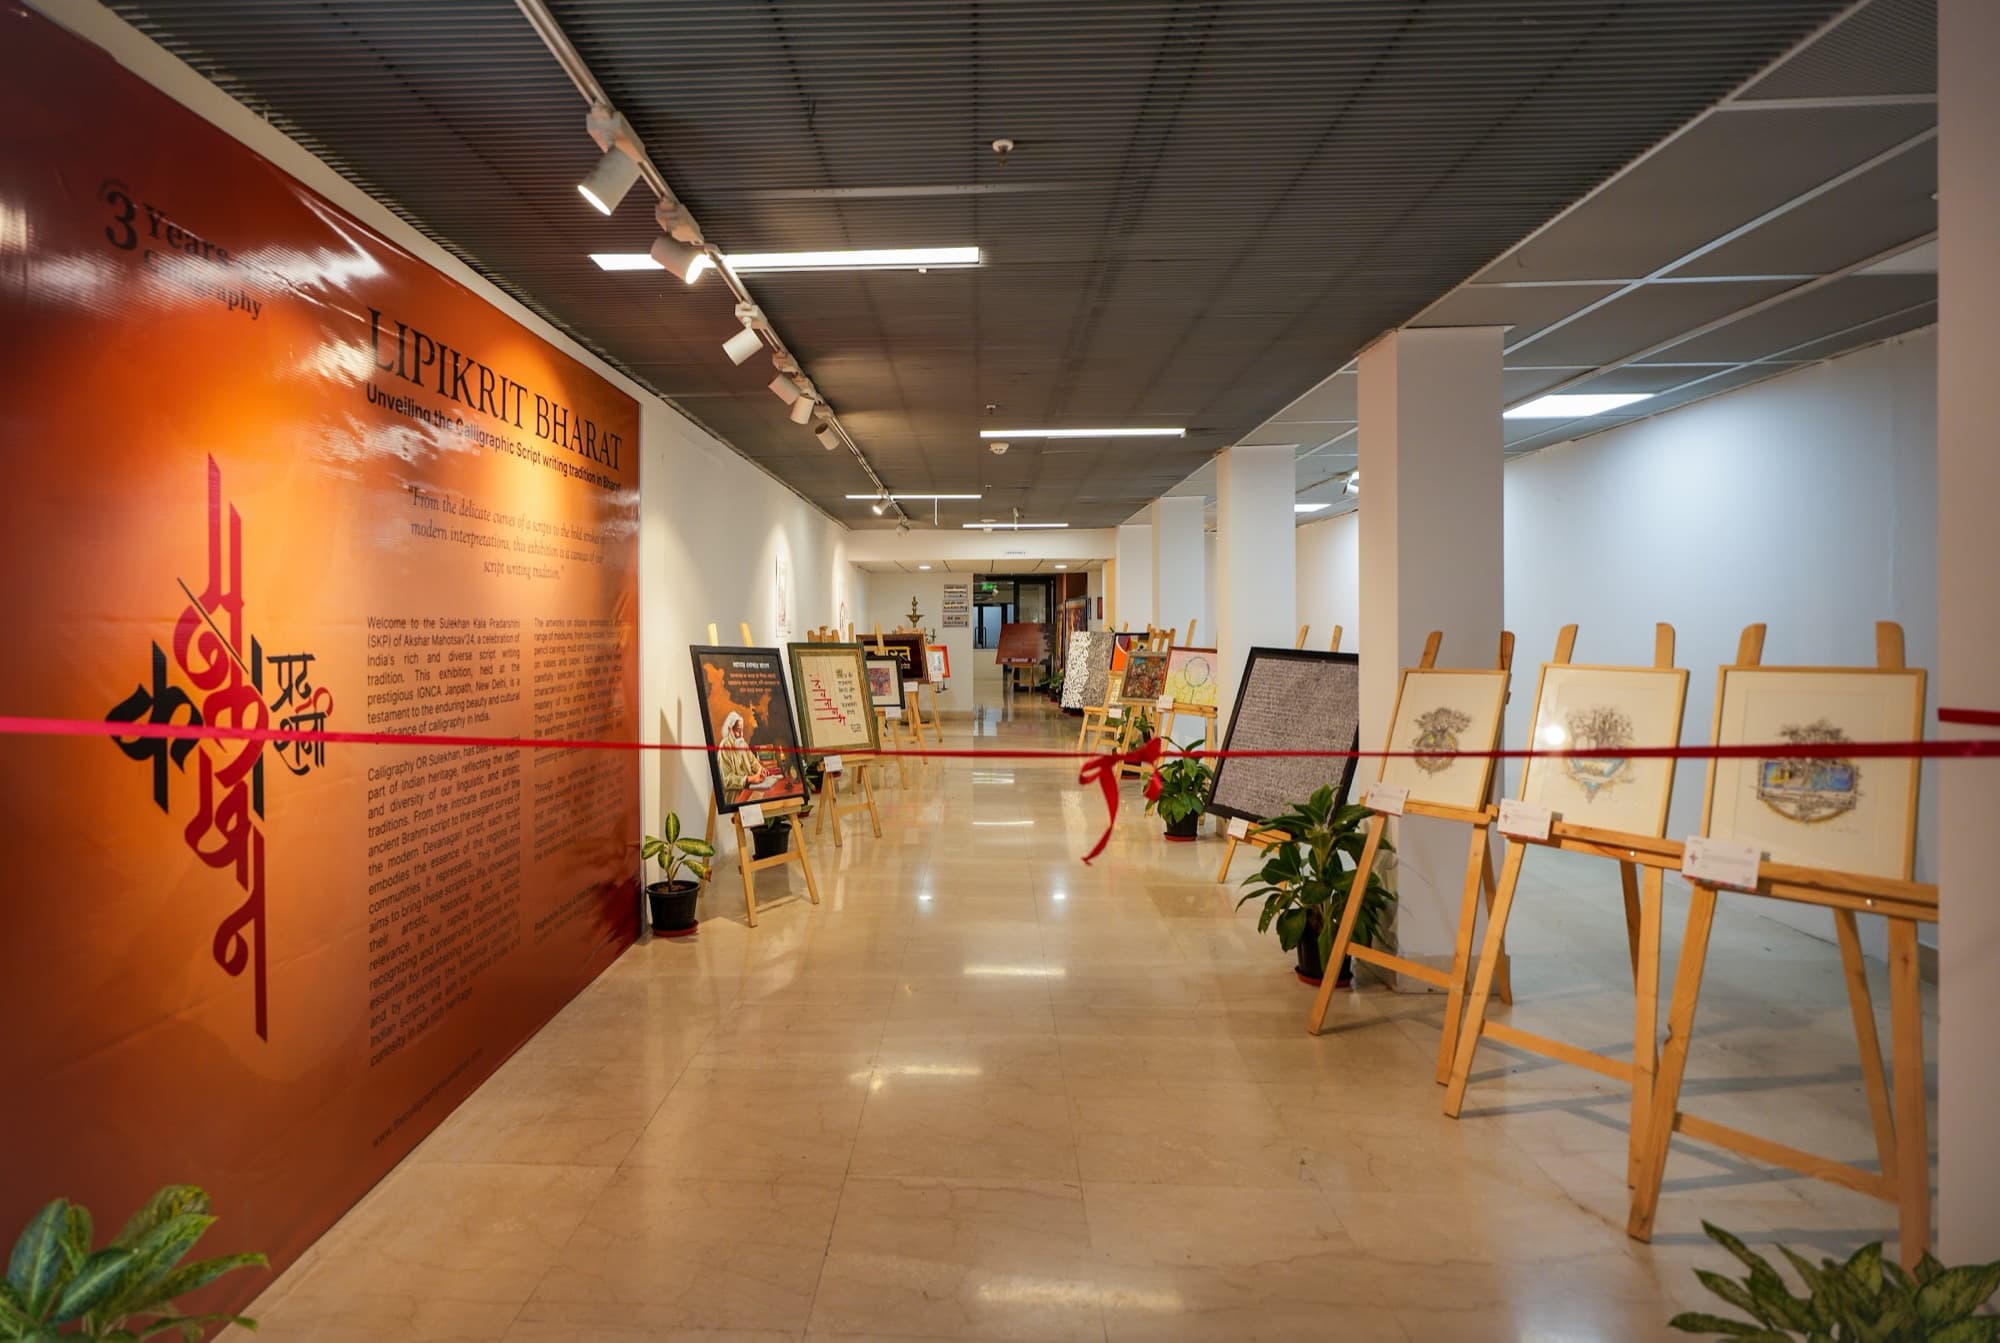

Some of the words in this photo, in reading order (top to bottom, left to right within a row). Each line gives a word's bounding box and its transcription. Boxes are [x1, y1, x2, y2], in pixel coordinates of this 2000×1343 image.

[105, 190, 138, 250] 3
[367, 306, 528, 430] LIPIKRIT
[535, 392, 623, 471] BHARAT
[366, 381, 431, 424] Unveiling
[433, 409, 454, 431] the
[455, 418, 515, 455] Calligraphic
[516, 442, 541, 465] Script
[542, 454, 568, 477] writing
[569, 463, 596, 485] tradition
[443, 494, 457, 514] the
[459, 497, 491, 522] delicate
[410, 519, 448, 541] modern
[483, 560, 504, 577] script
[367, 616, 407, 629] Welcome
[410, 618, 419, 629] to
[423, 618, 436, 629] the
[439, 617, 470, 629] Sulekhan
[367, 633, 391, 649] (SKP)
[393, 633, 402, 647] of
[403, 633, 430, 646] Akshar
[367, 653, 395, 666] India's
[404, 652, 419, 665] rich
[427, 652, 441, 663] and
[448, 651, 473, 662] diverse
[479, 650, 496, 660] script
[367, 671, 405, 686] tradition.
[415, 669, 430, 682] This
[367, 688, 414, 706] prestigious
[417, 684, 442, 698] IGNCA
[475, 680, 489, 691] New
[367, 707, 410, 724] testament
[411, 706, 420, 718] to
[421, 703, 434, 716] the
[435, 699, 465, 714] enduring
[466, 696, 488, 711] beauty
[418, 720, 427, 733] of
[428, 715, 465, 732] calligraphy
[368, 758, 414, 781] Calligraphy
[416, 755, 428, 769] OR
[368, 785, 385, 803] part
[389, 781, 398, 794] of
[402, 775, 425, 791] Indian
[461, 758, 491, 774] reflecting
[368, 804, 384, 819] and
[390, 793, 424, 812] diversity
[428, 788, 437, 801] of
[440, 785, 452, 798] our
[457, 774, 484, 792] linguistic
[368, 814, 409, 838] traditions.
[413, 807, 433, 823] From
[436, 802, 448, 815] the
[368, 837, 400, 857] ancient
[401, 825, 429, 845] Brahmi
[430, 818, 450, 835] script
[451, 814, 459, 825] to
[459, 809, 471, 823] the
[368, 862, 384, 877] the
[388, 848, 419, 868] modern
[423, 829, 463, 854] Devanagari
[368, 868, 410, 895] embodies
[414, 861, 427, 876] the
[430, 849, 460, 868] essence
[368, 881, 421, 915] communities
[368, 916, 389, 933] aims
[391, 910, 400, 923] to
[401, 899, 422, 918] bring
[423, 888, 443, 906] these
[368, 933, 389, 952] their
[368, 940, 412, 972] relevance.
[368, 954, 418, 991] recognizing
[369, 980, 407, 1010] essential
[369, 1009, 388, 1030] and
